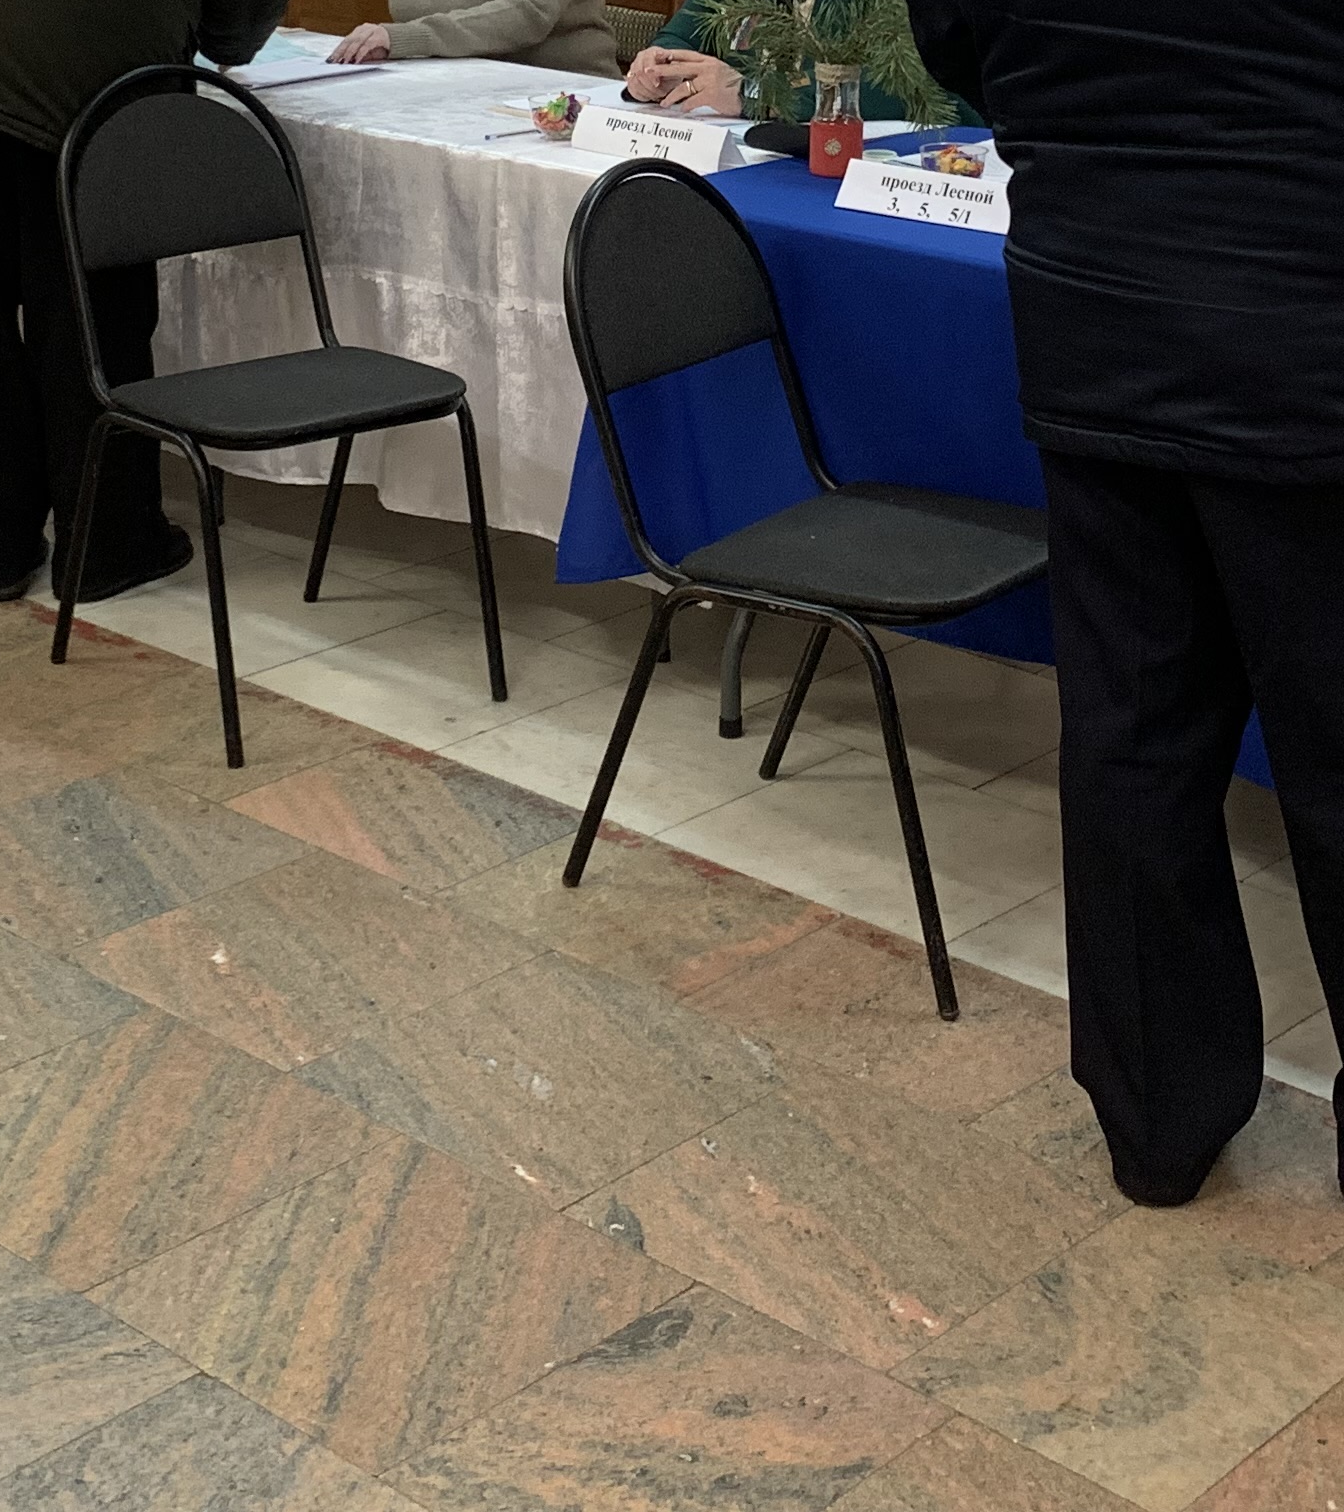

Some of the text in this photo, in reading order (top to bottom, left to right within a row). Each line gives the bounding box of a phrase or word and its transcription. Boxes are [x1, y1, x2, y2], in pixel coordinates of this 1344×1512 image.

[606, 117, 693, 142] проезд Лесной
[629, 139, 669, 160] 7, 7/1
[881, 176, 995, 205] проезд Лесной
[887, 197, 972, 225] 3, 5, 5/1
